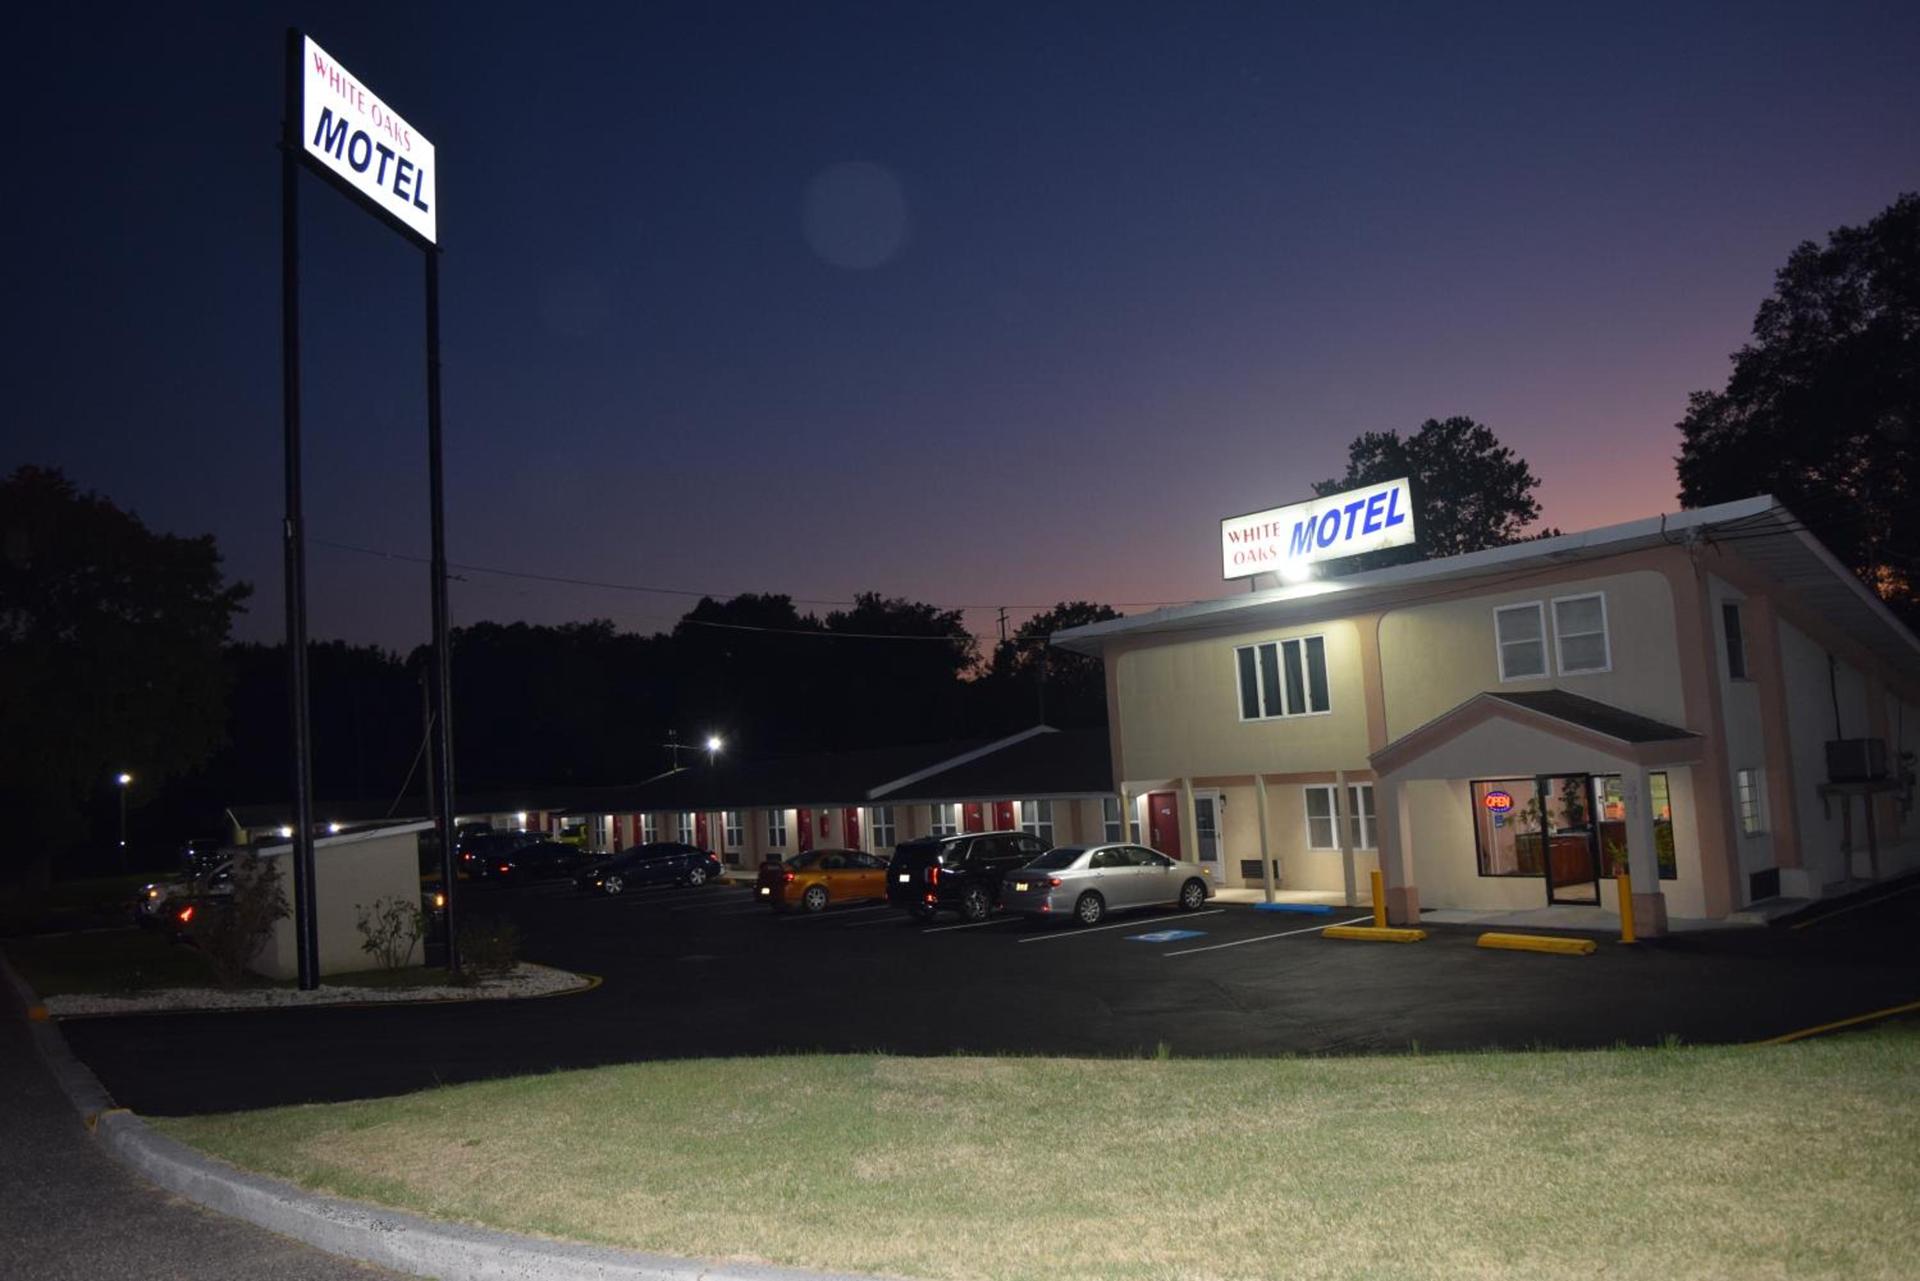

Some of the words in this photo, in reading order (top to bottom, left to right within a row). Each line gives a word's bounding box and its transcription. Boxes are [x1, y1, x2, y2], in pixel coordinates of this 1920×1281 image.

[314, 52, 365, 114] WHITE
[371, 104, 411, 152] OAKS
[313, 106, 429, 213] MOTEL
[1228, 521, 1281, 544] WHITE
[1289, 487, 1405, 559] MOTEL
[1233, 547, 1277, 566] OAKS
[1486, 795, 1510, 808] OPEN
